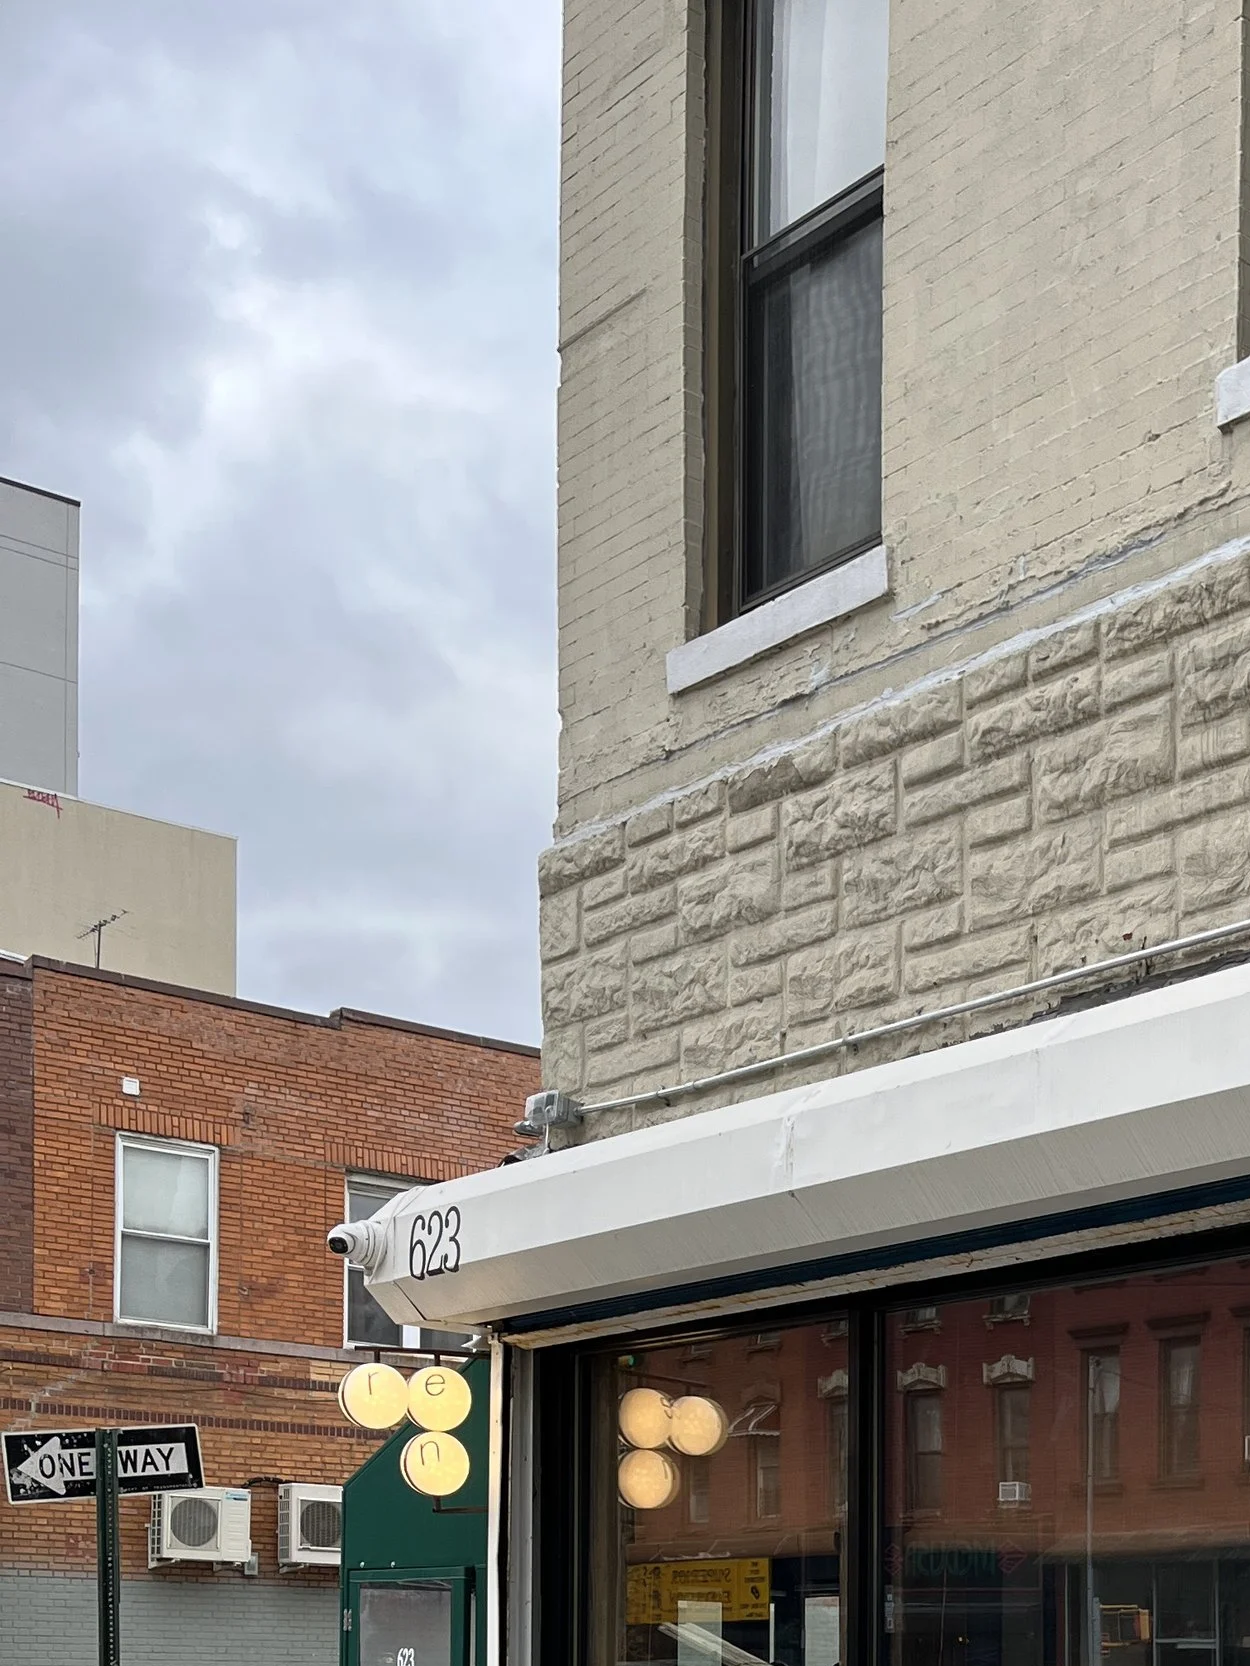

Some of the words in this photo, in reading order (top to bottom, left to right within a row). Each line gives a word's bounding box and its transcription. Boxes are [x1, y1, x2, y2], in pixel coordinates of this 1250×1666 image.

[409, 1205, 461, 1281] 623
[39, 1451, 95, 1480] ONE
[118, 1446, 175, 1474] WAY
